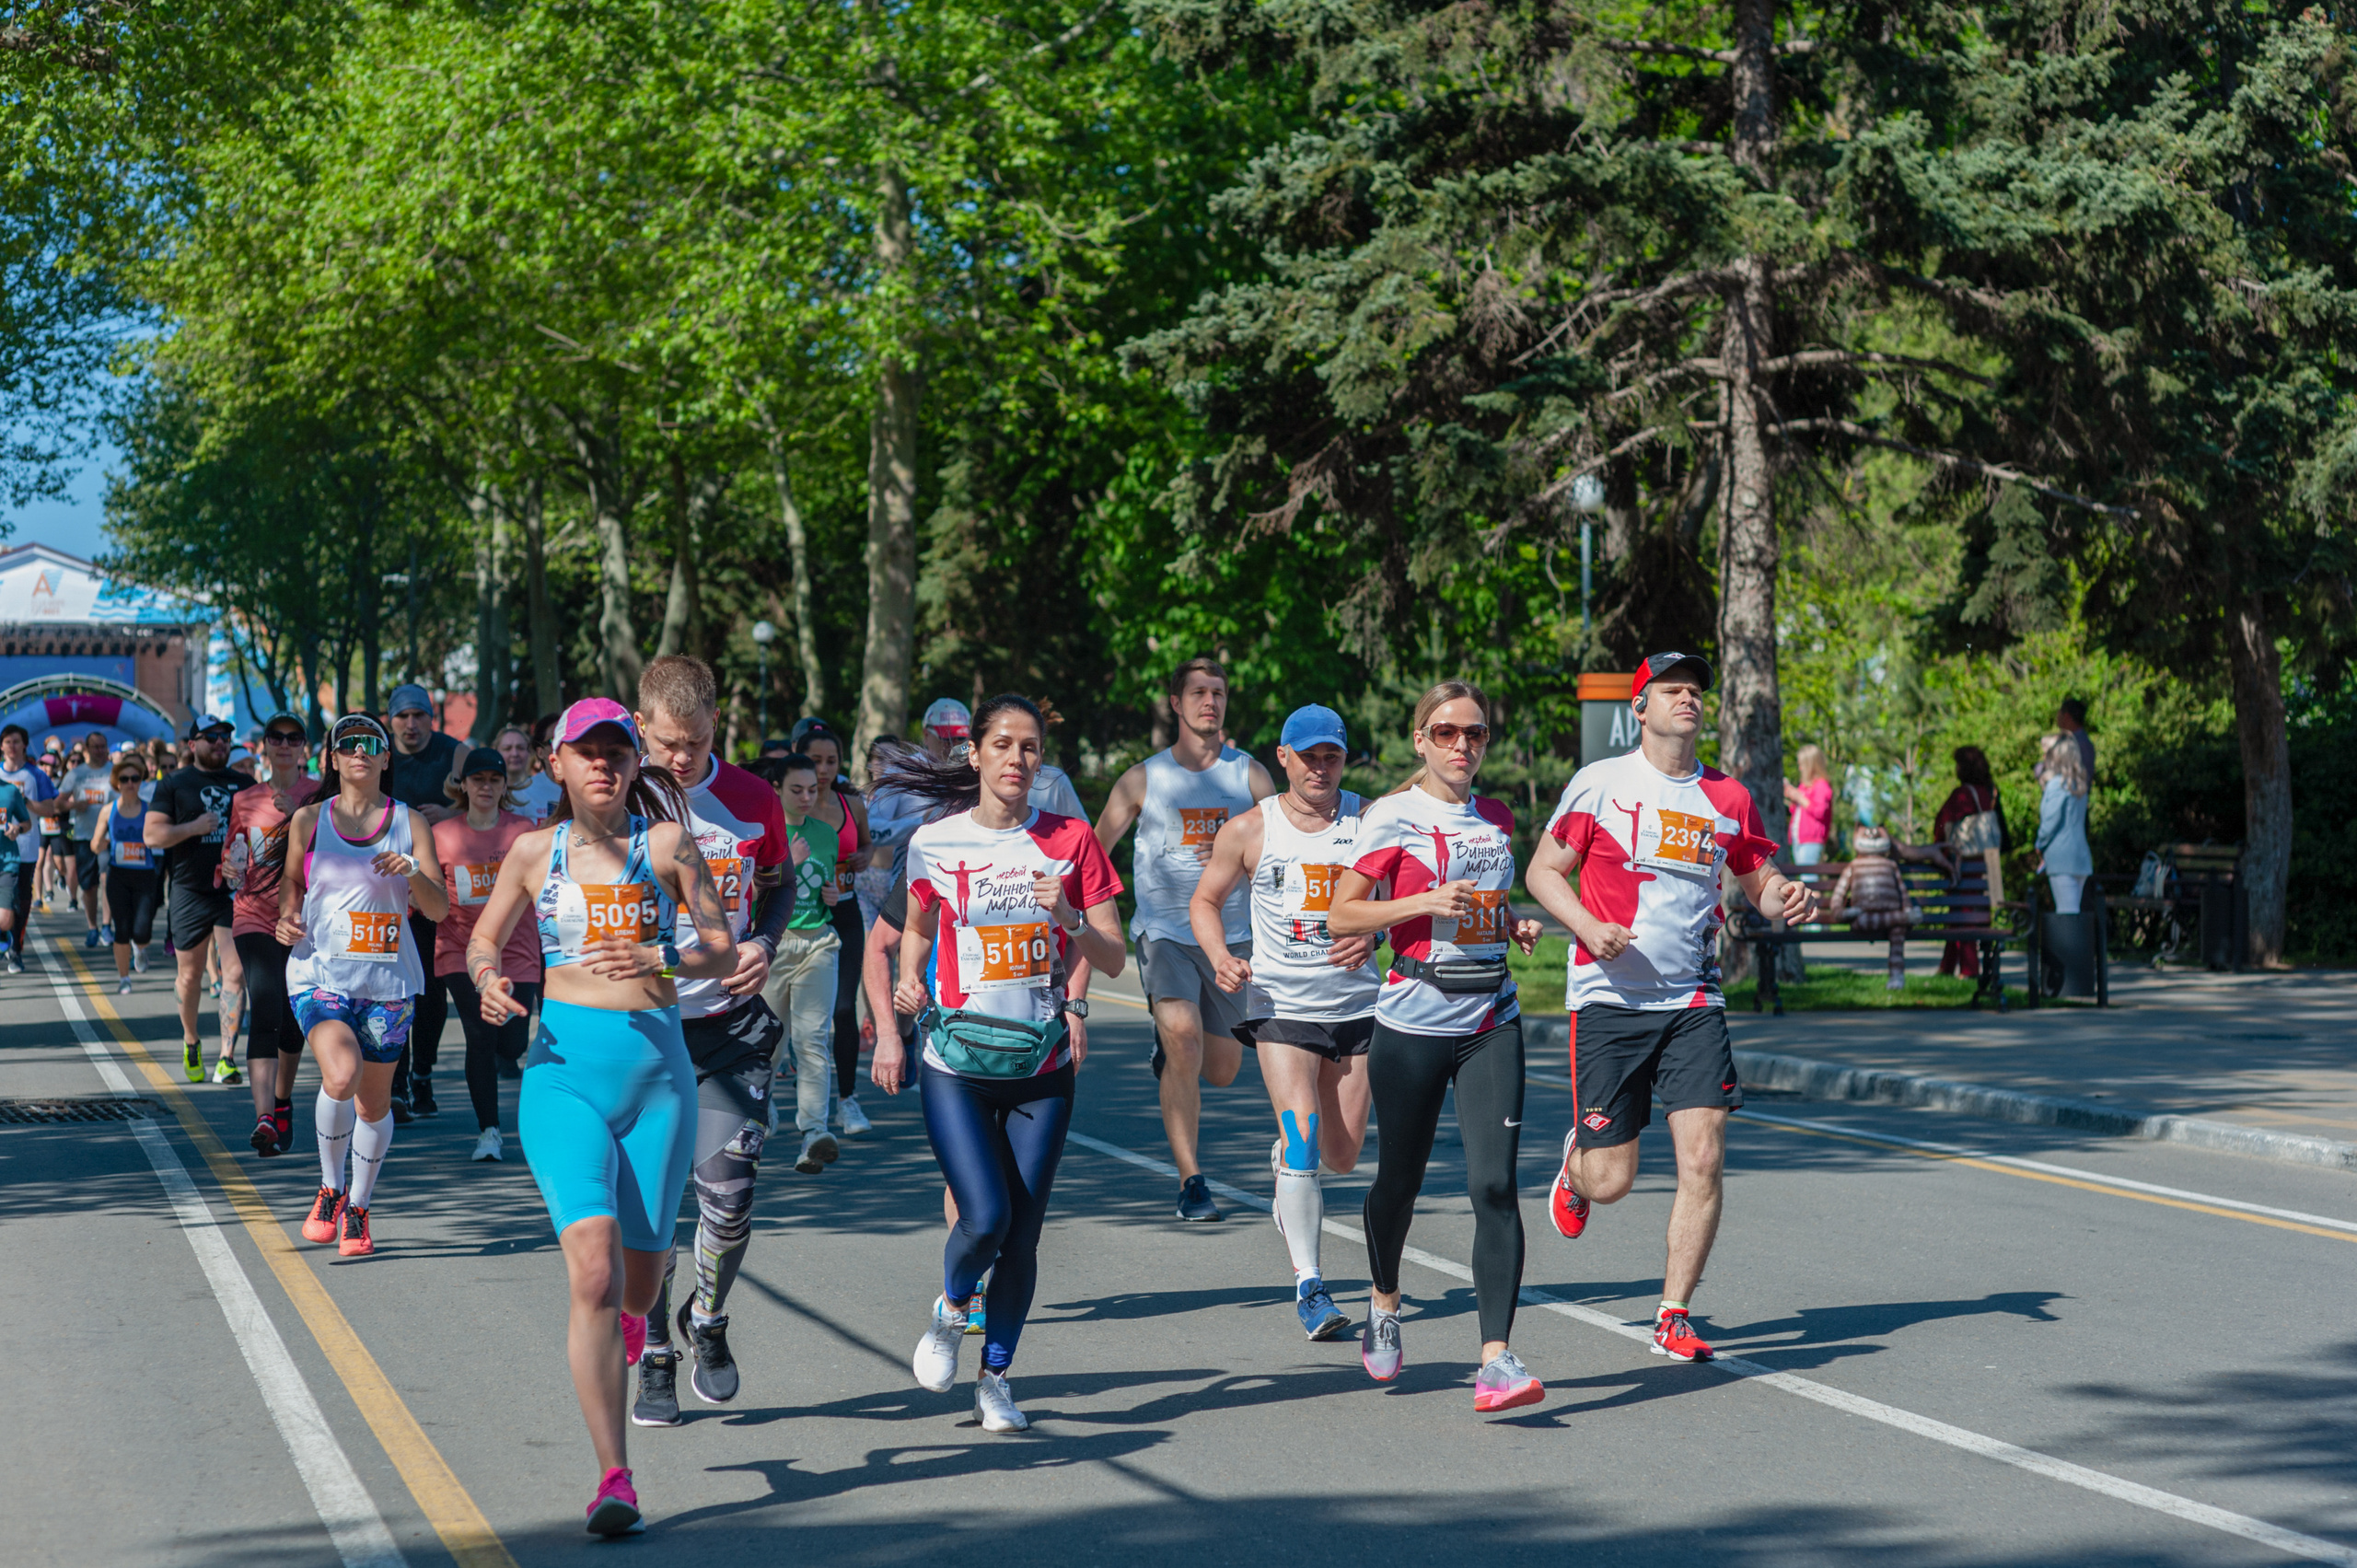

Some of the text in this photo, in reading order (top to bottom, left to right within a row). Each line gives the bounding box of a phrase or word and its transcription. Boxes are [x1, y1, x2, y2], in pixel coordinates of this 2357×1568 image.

[1452, 839, 1507, 860] Винный
[1469, 833, 1492, 847] первый
[1664, 825, 1713, 853] 2394
[996, 865, 1028, 883] первый
[591, 900, 656, 927] 5095
[1461, 906, 1504, 929] 5111
[354, 924, 397, 942] 5119
[987, 939, 1045, 964] 5110
